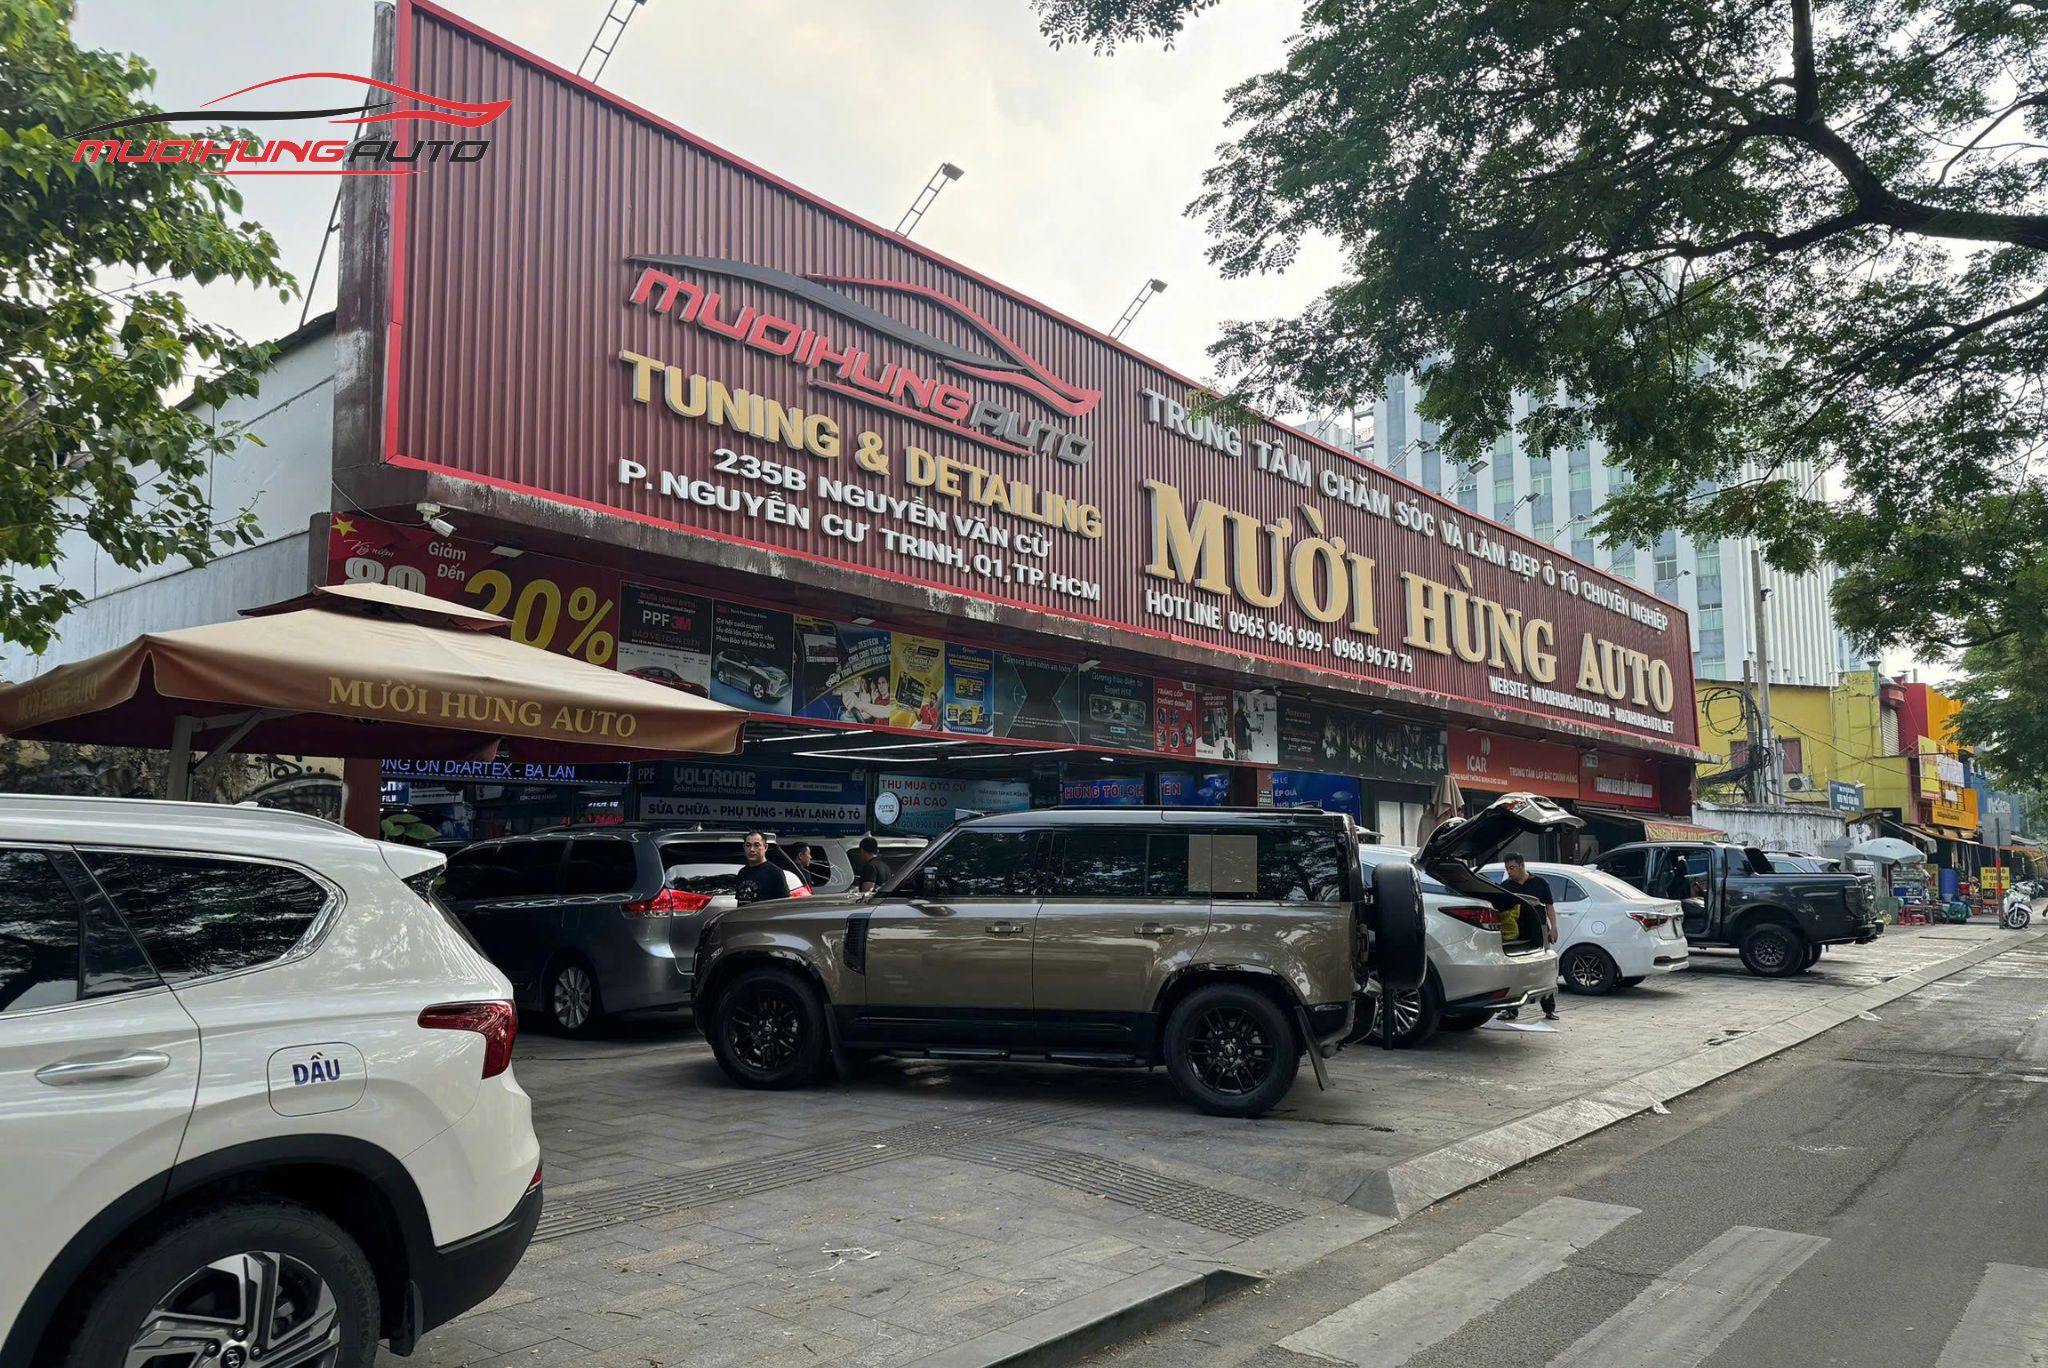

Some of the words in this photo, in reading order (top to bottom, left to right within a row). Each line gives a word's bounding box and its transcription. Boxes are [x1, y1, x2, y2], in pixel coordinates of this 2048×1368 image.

[618, 348, 840, 459] TUNING
[854, 431, 891, 477] &
[905, 445, 1103, 540] DETAILING
[618, 458, 653, 490] P.
[659, 470, 810, 530] NGUYỄN
[820, 513, 871, 543] CƯ
[713, 448, 808, 491] 235B
[817, 475, 947, 532] NGUYỄN
[953, 514, 1009, 549] VĂN
[1013, 530, 1054, 558] CỪ
[1142, 387, 1242, 458] TRUNG
[1253, 438, 1312, 488] TÂM
[1319, 469, 1391, 519] CHĂM
[1440, 515, 1465, 550] VÀ
[1466, 529, 1506, 567] LÀM
[1508, 550, 1541, 583] ĐẸP
[1542, 560, 1556, 587] Ô
[1558, 569, 1580, 597] TÔ
[1580, 581, 1630, 617] CHUYÊN
[1630, 602, 1669, 635] NGHIỆP
[428, 541, 467, 561] Giảm
[437, 563, 466, 581] Đến
[1142, 477, 1379, 635] MƯỜI
[1400, 562, 1558, 684] HÙNG
[1575, 632, 1674, 714] AUTO
[464, 569, 616, 665] 20%
[642, 609, 671, 627] PPF
[671, 614, 692, 632] 3M
[1228, 611, 1266, 640] 0965
[1267, 621, 1294, 647] 966
[1296, 628, 1323, 652] 999
[1332, 637, 1365, 662] 0968
[328, 676, 428, 714] MƯỜI
[440, 688, 542, 727] HÙNG
[551, 705, 637, 737] AUTO
[445, 760, 512, 776] DrARTEX
[525, 764, 544, 777] BA
[548, 765, 576, 779] LAN
[1466, 754, 1488, 774] ICAR
[905, 780, 927, 791] MUA
[924, 796, 948, 808] CAO
[648, 799, 674, 816] SỬA
[677, 801, 711, 817] CHỮA
[720, 805, 743, 819] PHỤ
[746, 804, 776, 818] TÙNG
[784, 804, 807, 819] MÁY
[808, 807, 836, 822] LẠNH
[838, 805, 846, 820] Ô
[848, 806, 861, 820] TÔ
[292, 1052, 341, 1086] DẦU
